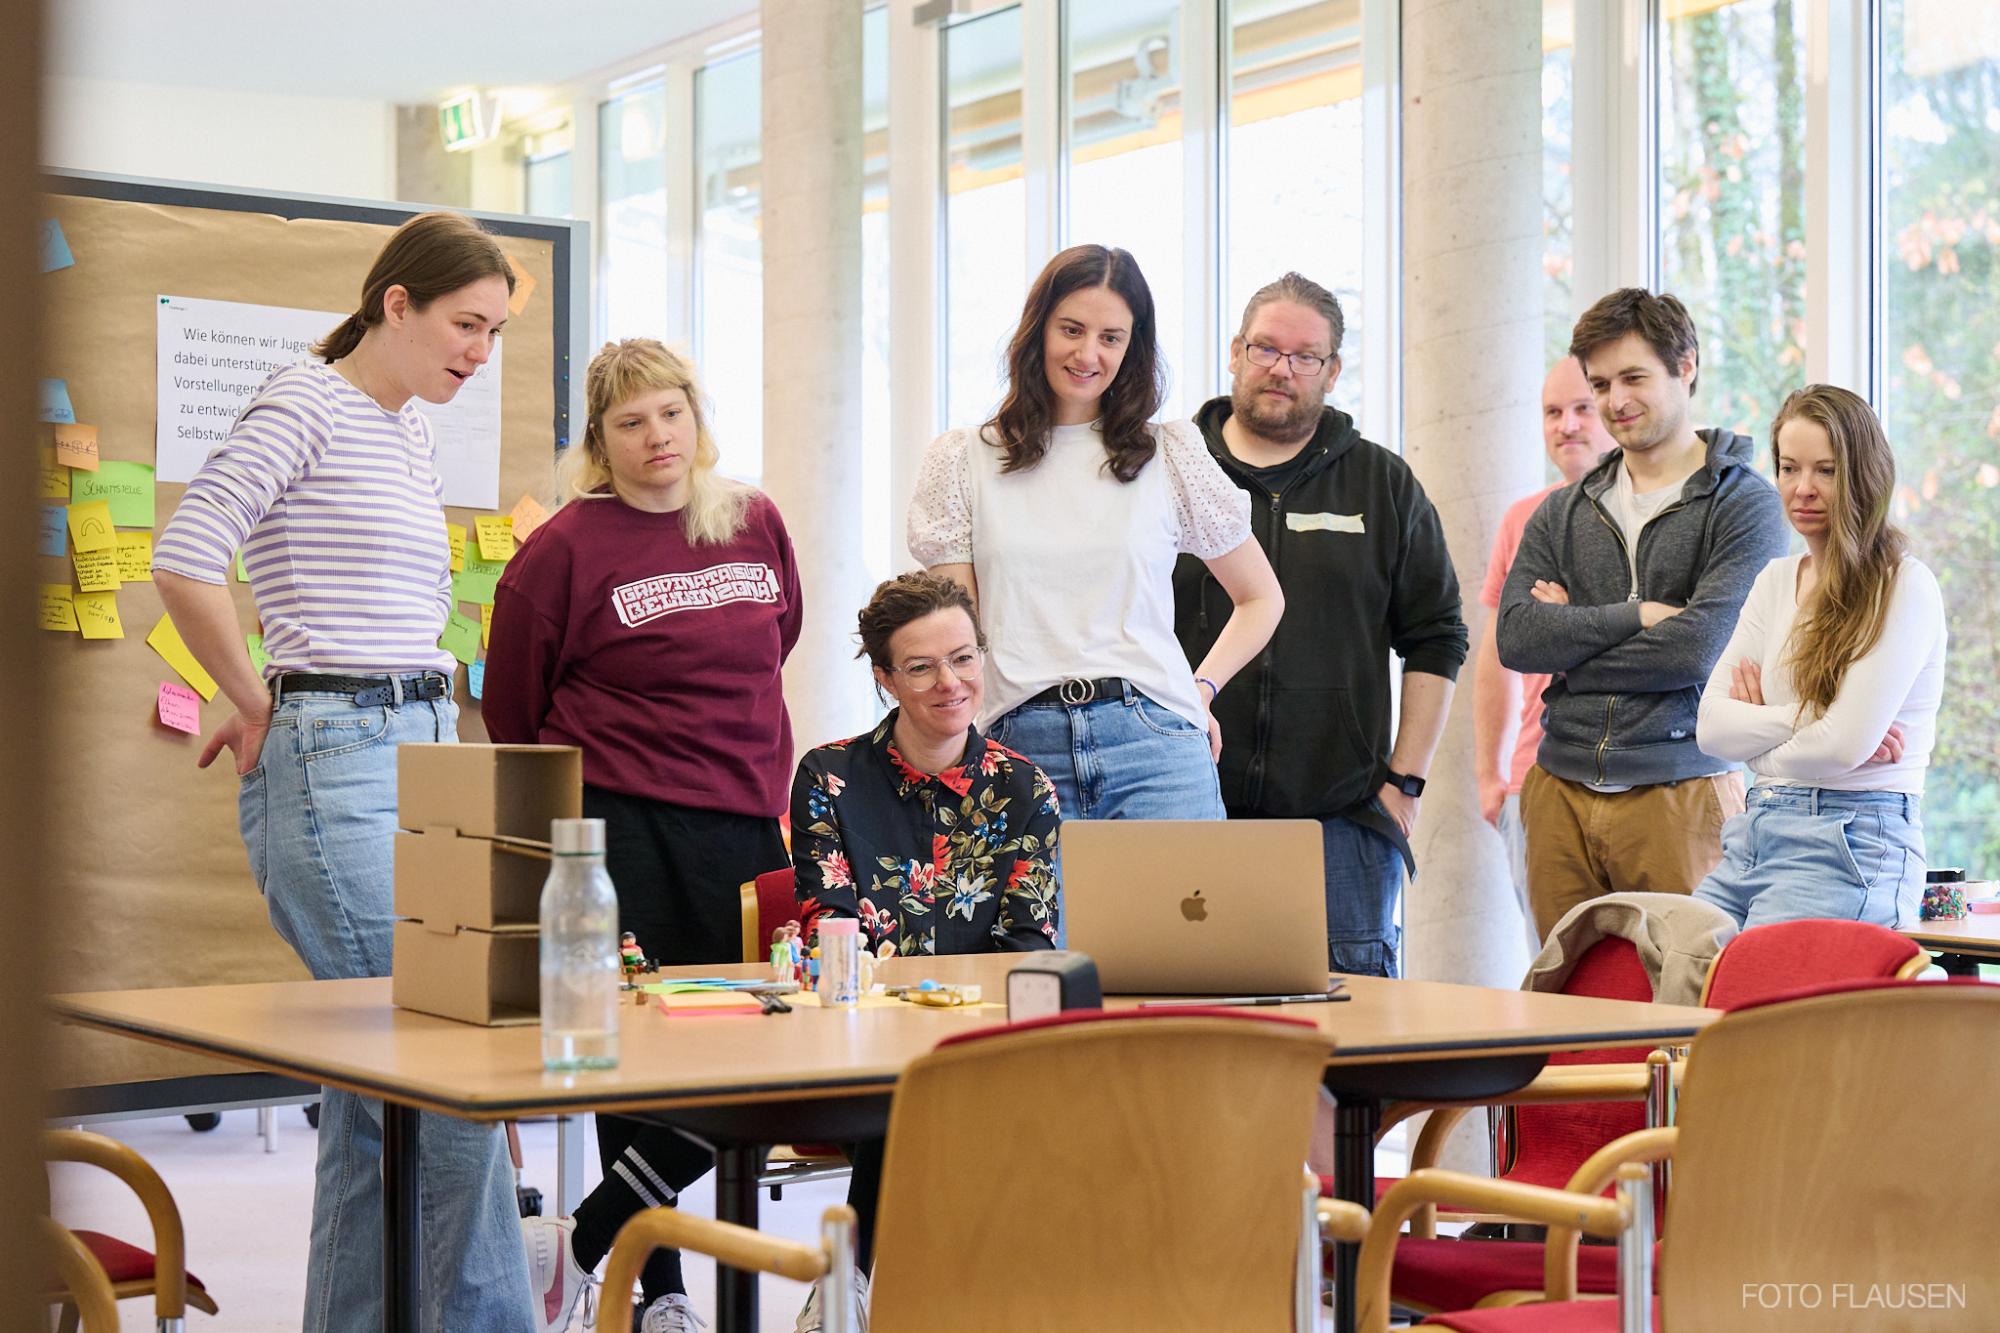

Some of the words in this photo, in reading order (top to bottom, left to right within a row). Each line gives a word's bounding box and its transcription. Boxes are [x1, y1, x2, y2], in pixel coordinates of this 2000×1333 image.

[183, 327, 207, 341] Wie
[211, 329, 255, 346] können
[259, 336, 277, 348] wir
[174, 351, 207, 366] dabei
[211, 357, 283, 372] unterstütze
[174, 376, 257, 397] Vorstellungen
[180, 403, 194, 414] zu
[177, 425, 231, 441] Selbstwi
[619, 566, 731, 604] GRADINATA
[625, 580, 771, 621] BELLINZONA
